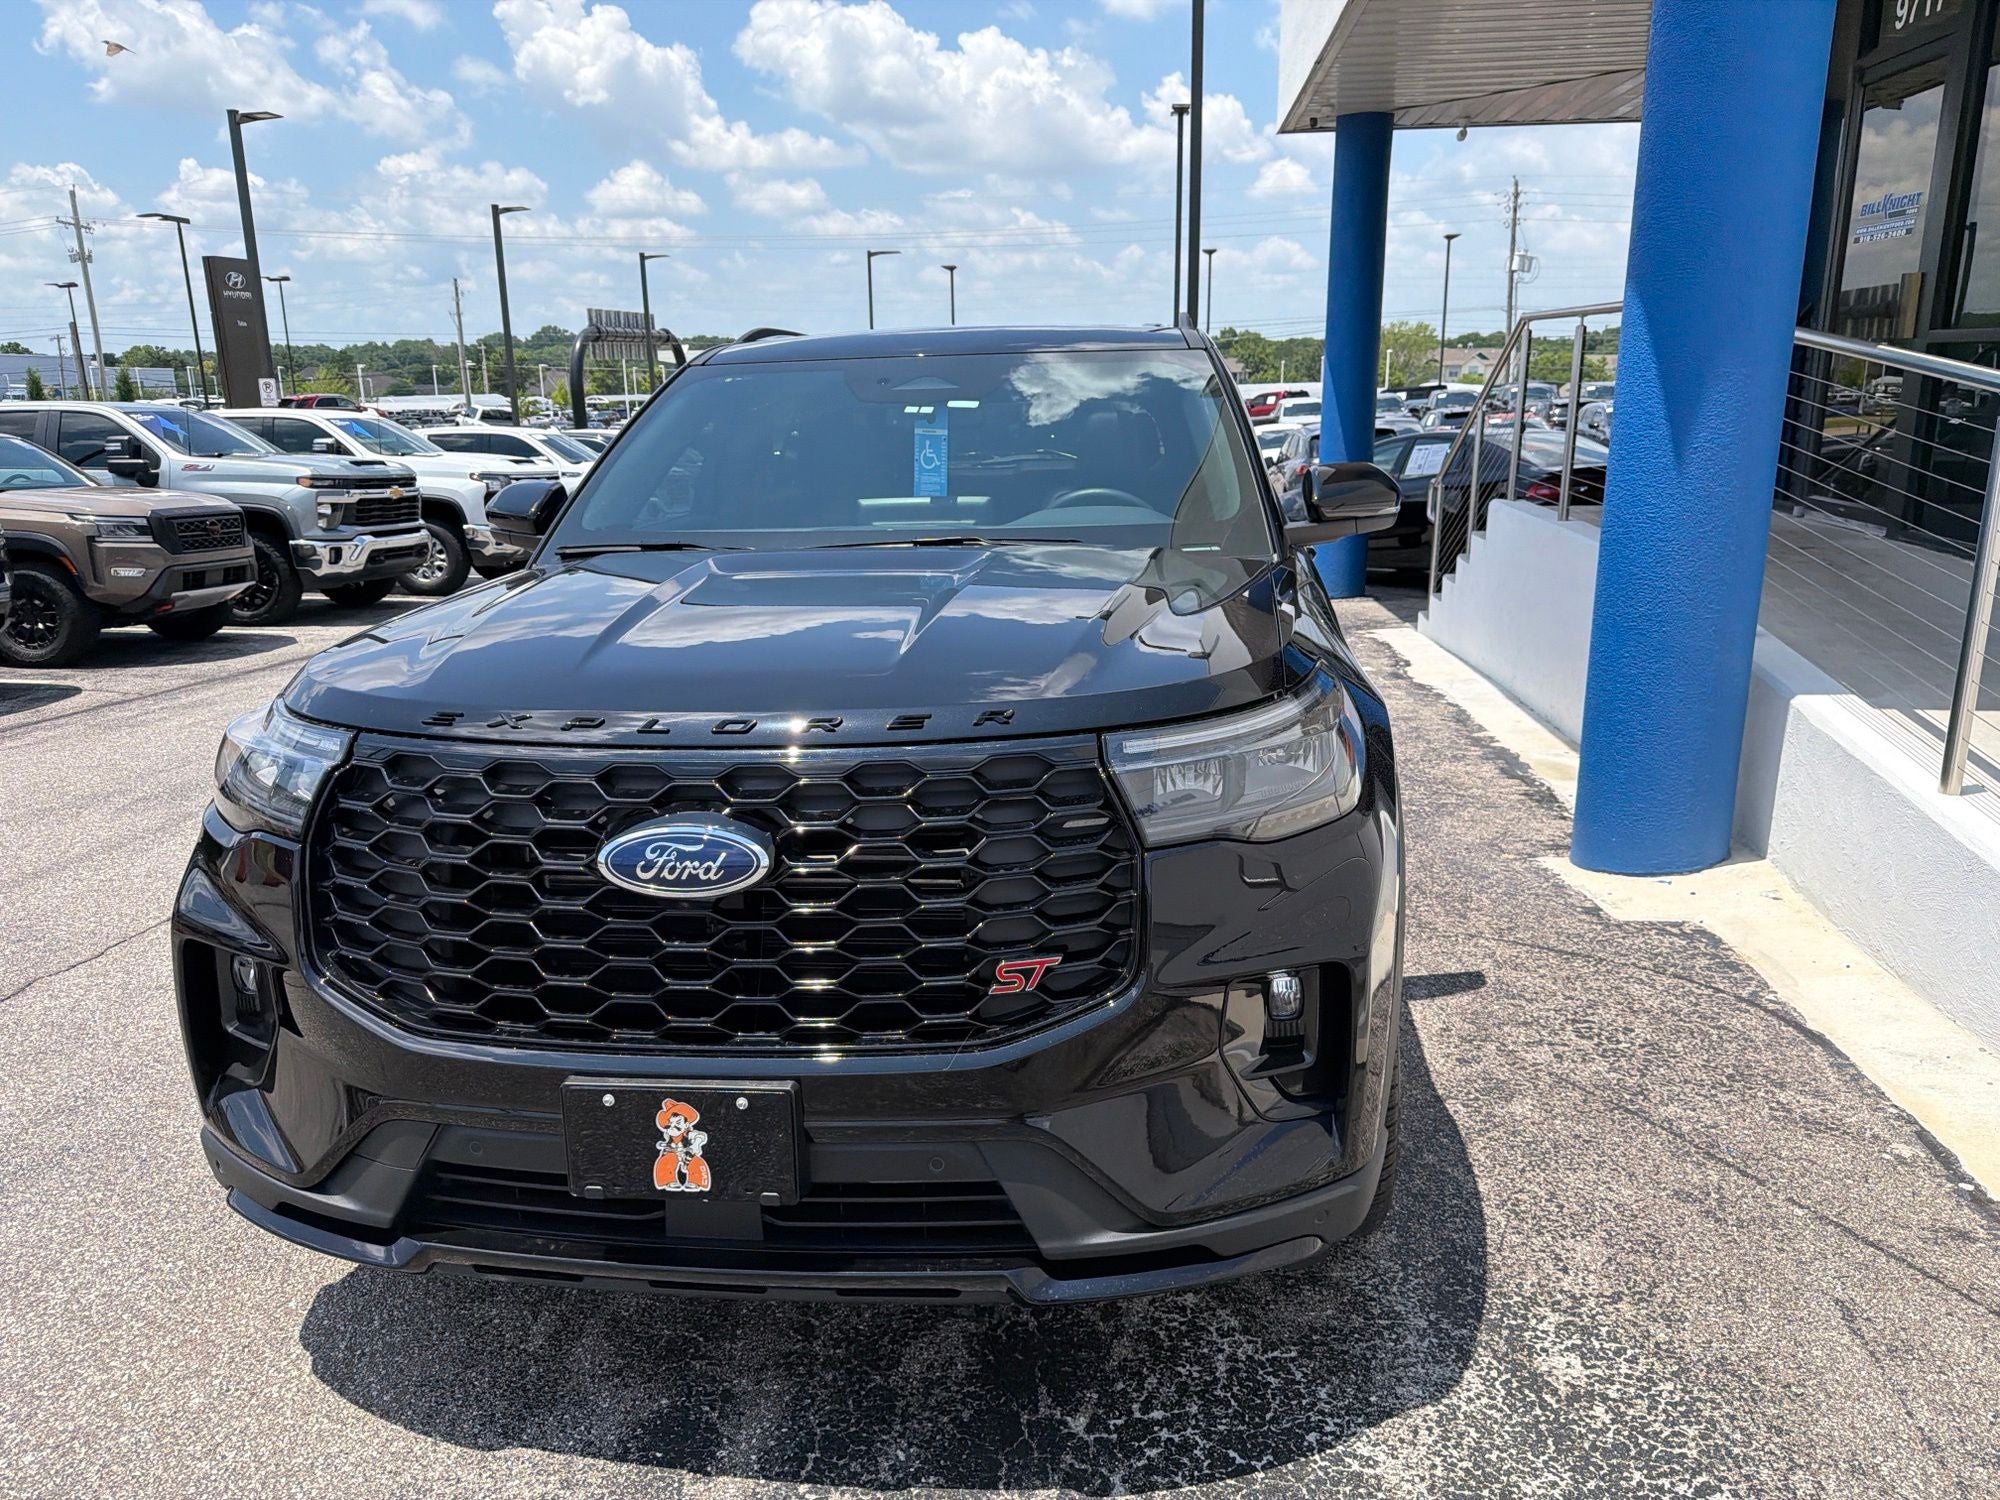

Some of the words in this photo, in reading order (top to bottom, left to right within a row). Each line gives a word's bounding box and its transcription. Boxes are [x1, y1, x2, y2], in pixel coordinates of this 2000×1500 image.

[421, 708, 1015, 735] EXPLORER
[636, 842, 727, 880] Ford
[988, 956, 1062, 994] ST
